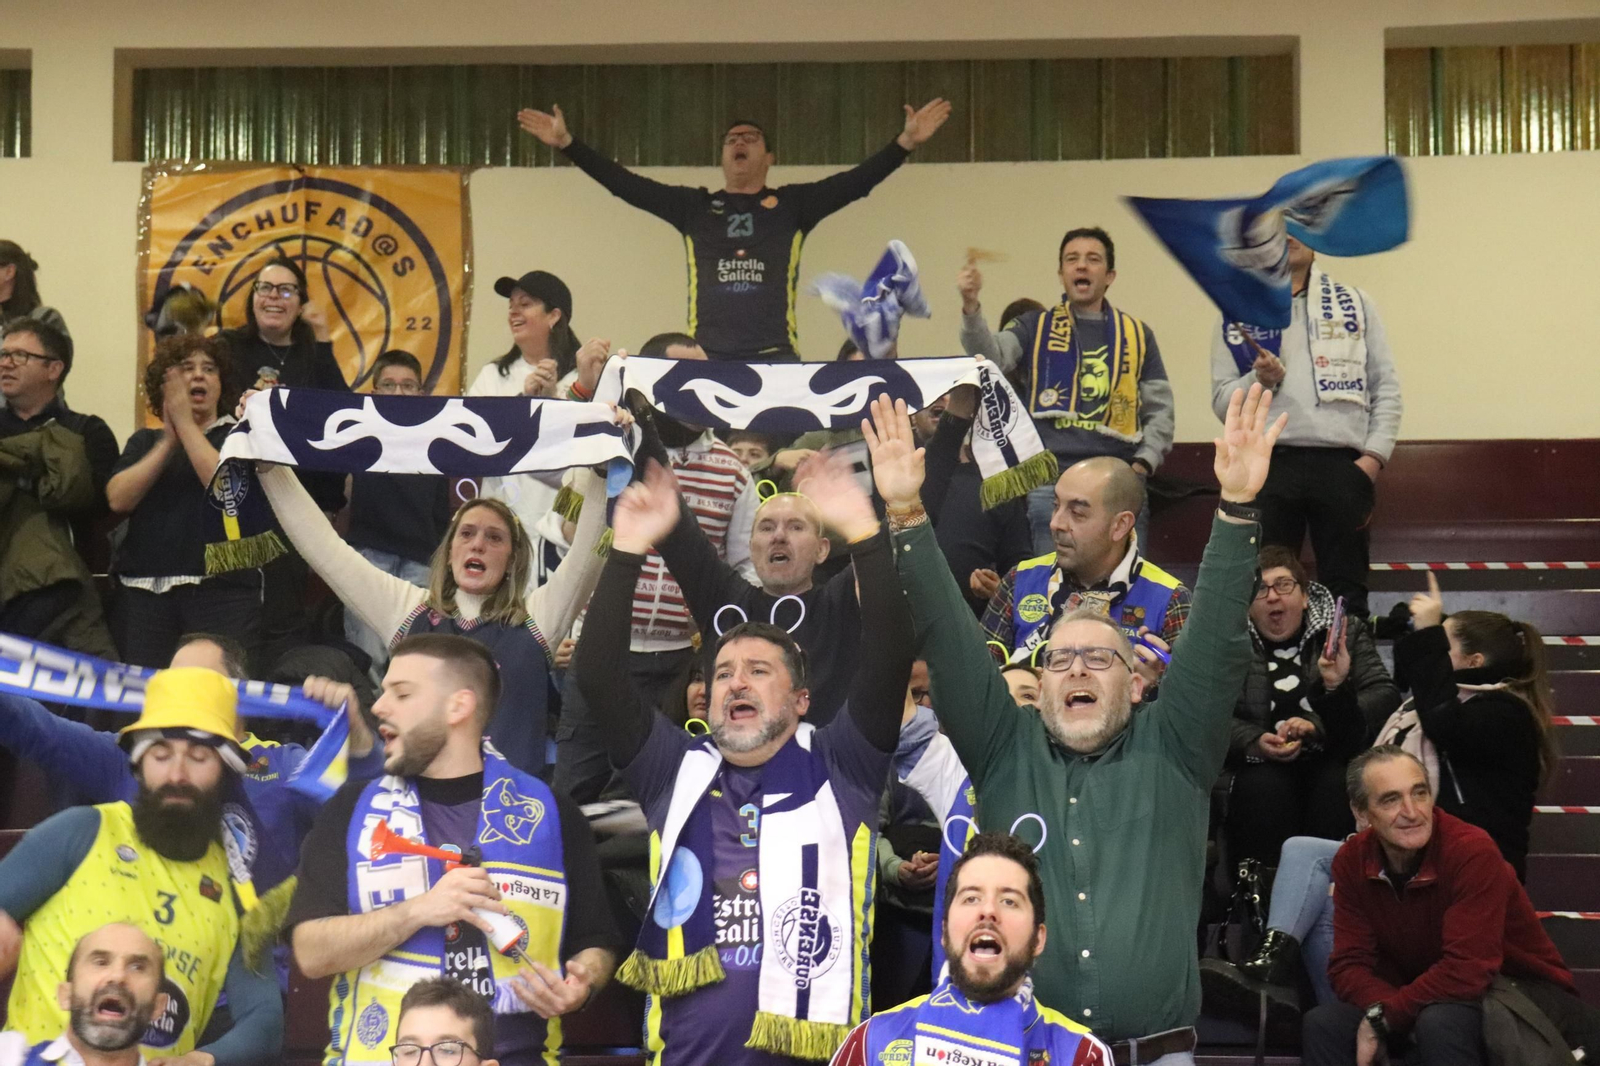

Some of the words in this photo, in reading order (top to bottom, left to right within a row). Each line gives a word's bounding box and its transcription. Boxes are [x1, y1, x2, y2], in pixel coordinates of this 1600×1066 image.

[727, 212, 754, 238] 23
[192, 201, 415, 277] ENCHUFAD@S
[717, 258, 765, 271] Estrella
[718, 270, 763, 282] Galicia
[1333, 283, 1359, 334] NCESTO
[406, 316, 432, 331] 22
[739, 803, 761, 848] 3
[153, 890, 178, 926] 3
[543, 890, 560, 905] La
